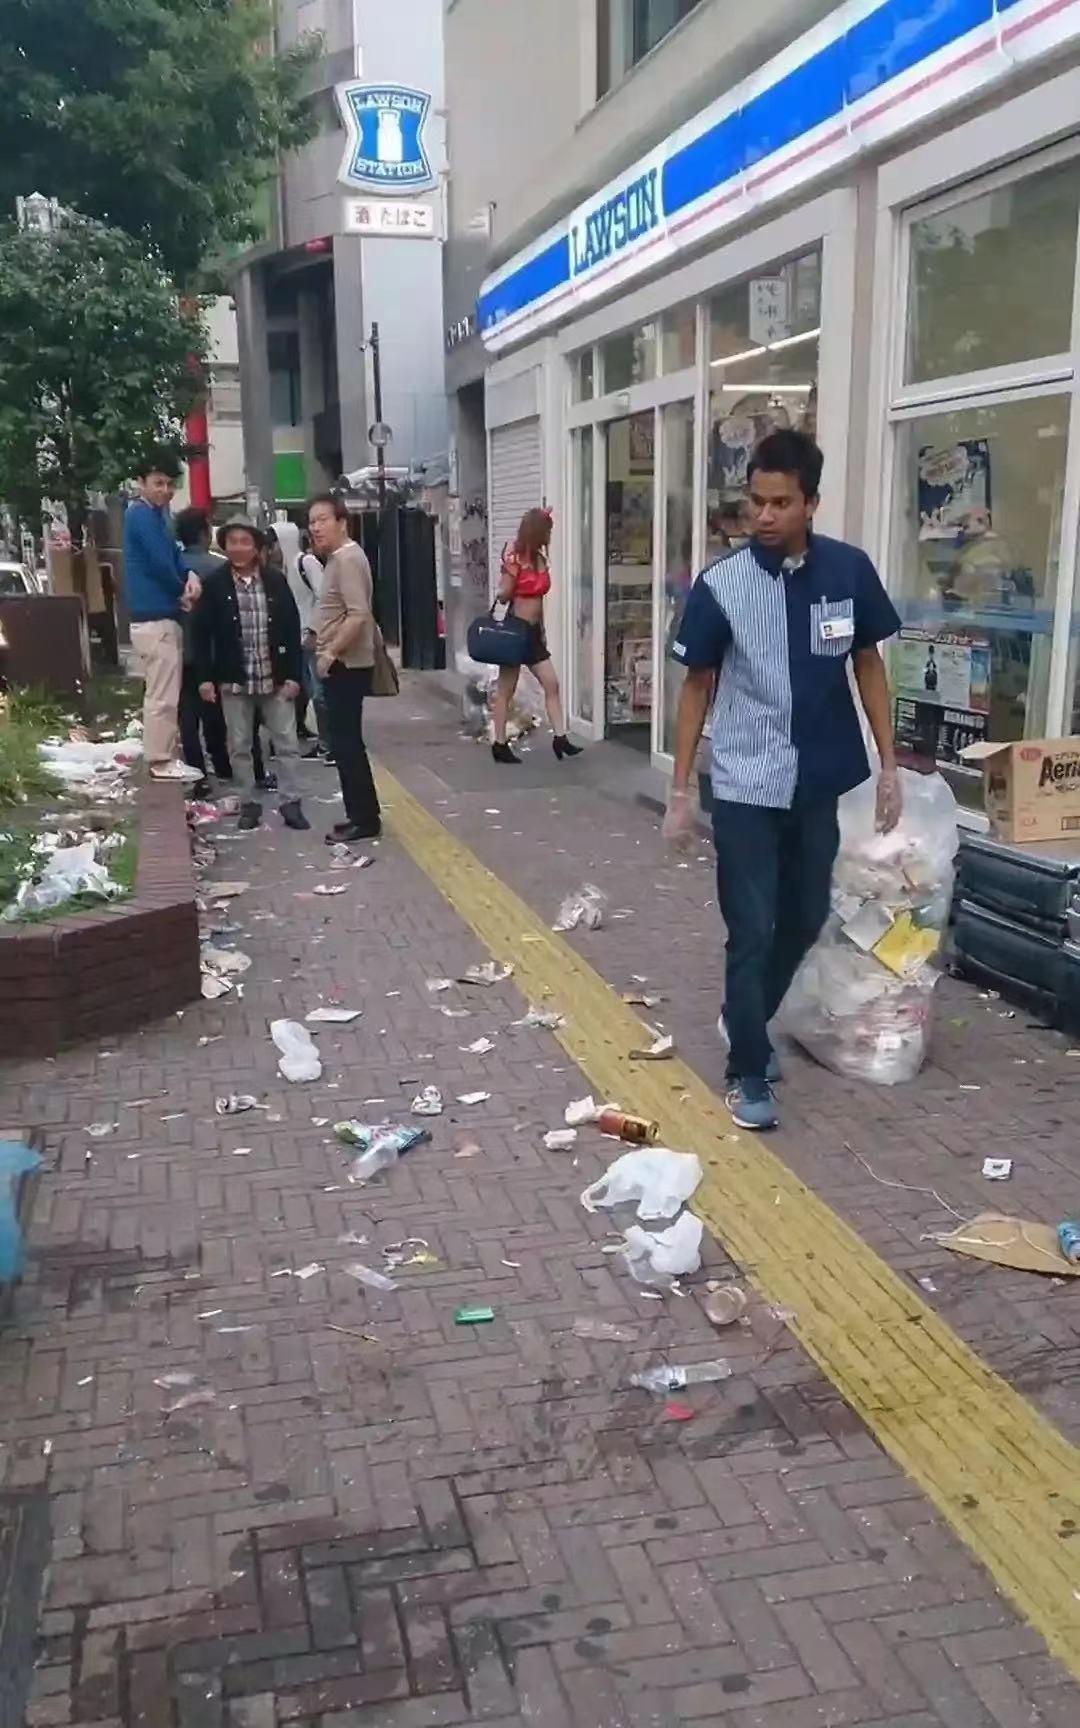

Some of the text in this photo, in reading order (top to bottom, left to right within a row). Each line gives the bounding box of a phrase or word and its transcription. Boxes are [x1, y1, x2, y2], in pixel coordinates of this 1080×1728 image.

[355, 94, 424, 113] LAWSON
[356, 160, 425, 176] STATION
[380, 207, 427, 227] たばこ
[571, 167, 659, 276] LAWSON
[1038, 755, 1080, 786] Aeri
